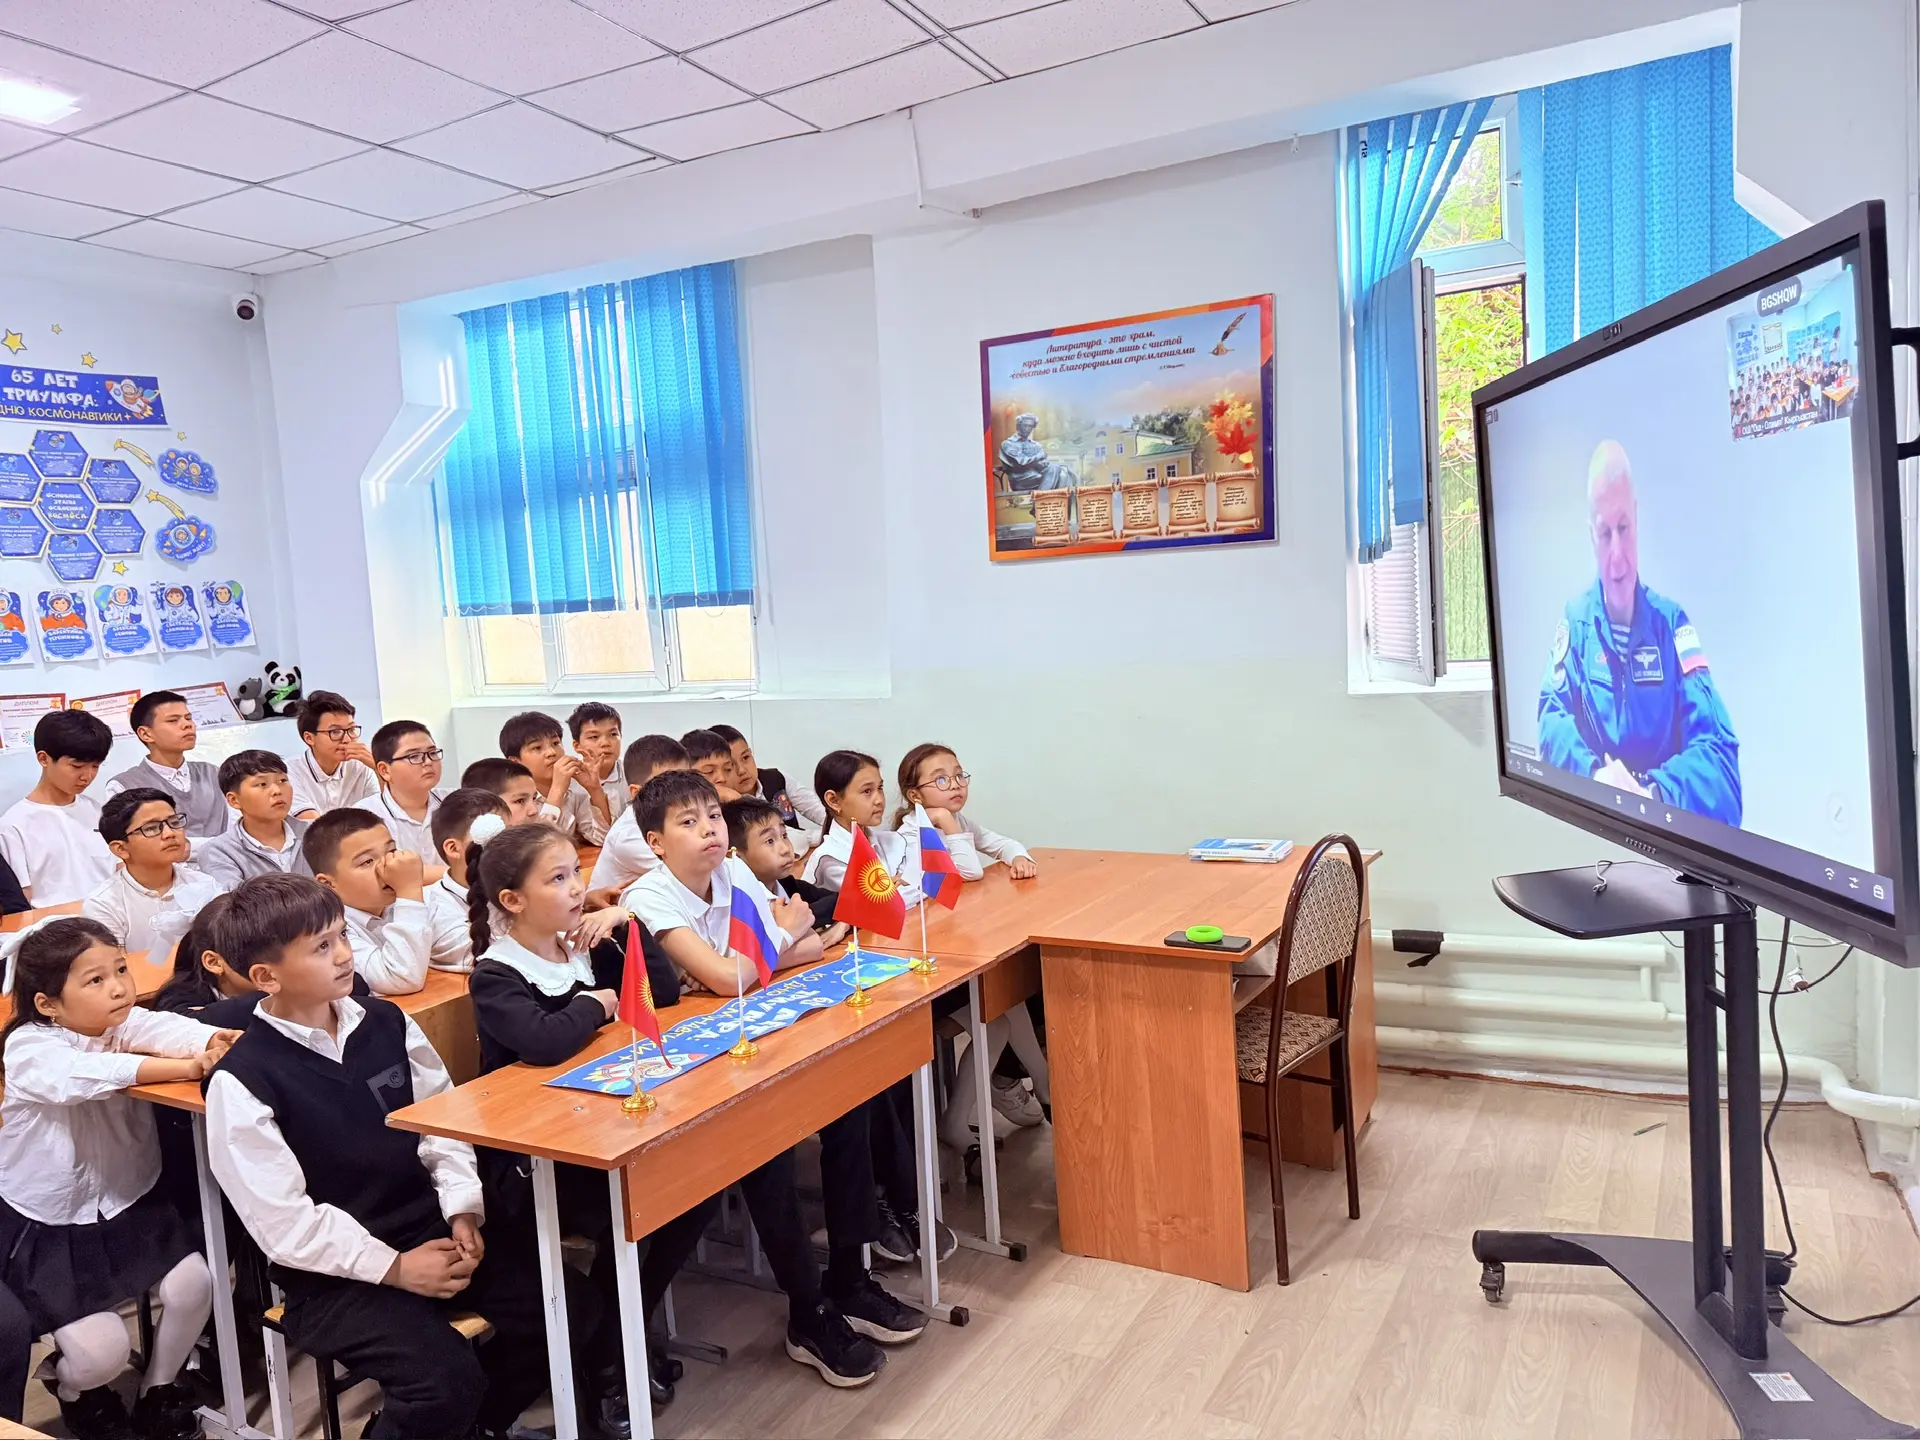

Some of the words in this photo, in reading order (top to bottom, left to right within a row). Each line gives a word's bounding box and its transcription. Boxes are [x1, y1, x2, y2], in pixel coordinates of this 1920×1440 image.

[1022, 358, 1043, 369] куда
[1044, 353, 1075, 365] можно
[1076, 348, 1114, 360] входить
[1115, 343, 1140, 354] лишь
[1142, 342, 1147, 350] с
[1149, 335, 1183, 350] чистой
[1046, 338, 1102, 355] Литература
[1108, 334, 1127, 344] это
[1052, 366, 1058, 374] и
[1059, 357, 1123, 373] благородными
[1124, 347, 1196, 364] стремлениями
[11, 368, 35, 384] 65
[43, 373, 78, 388] ЛЕТ
[28, 407, 123, 422] КОСМОНАВТИКИ
